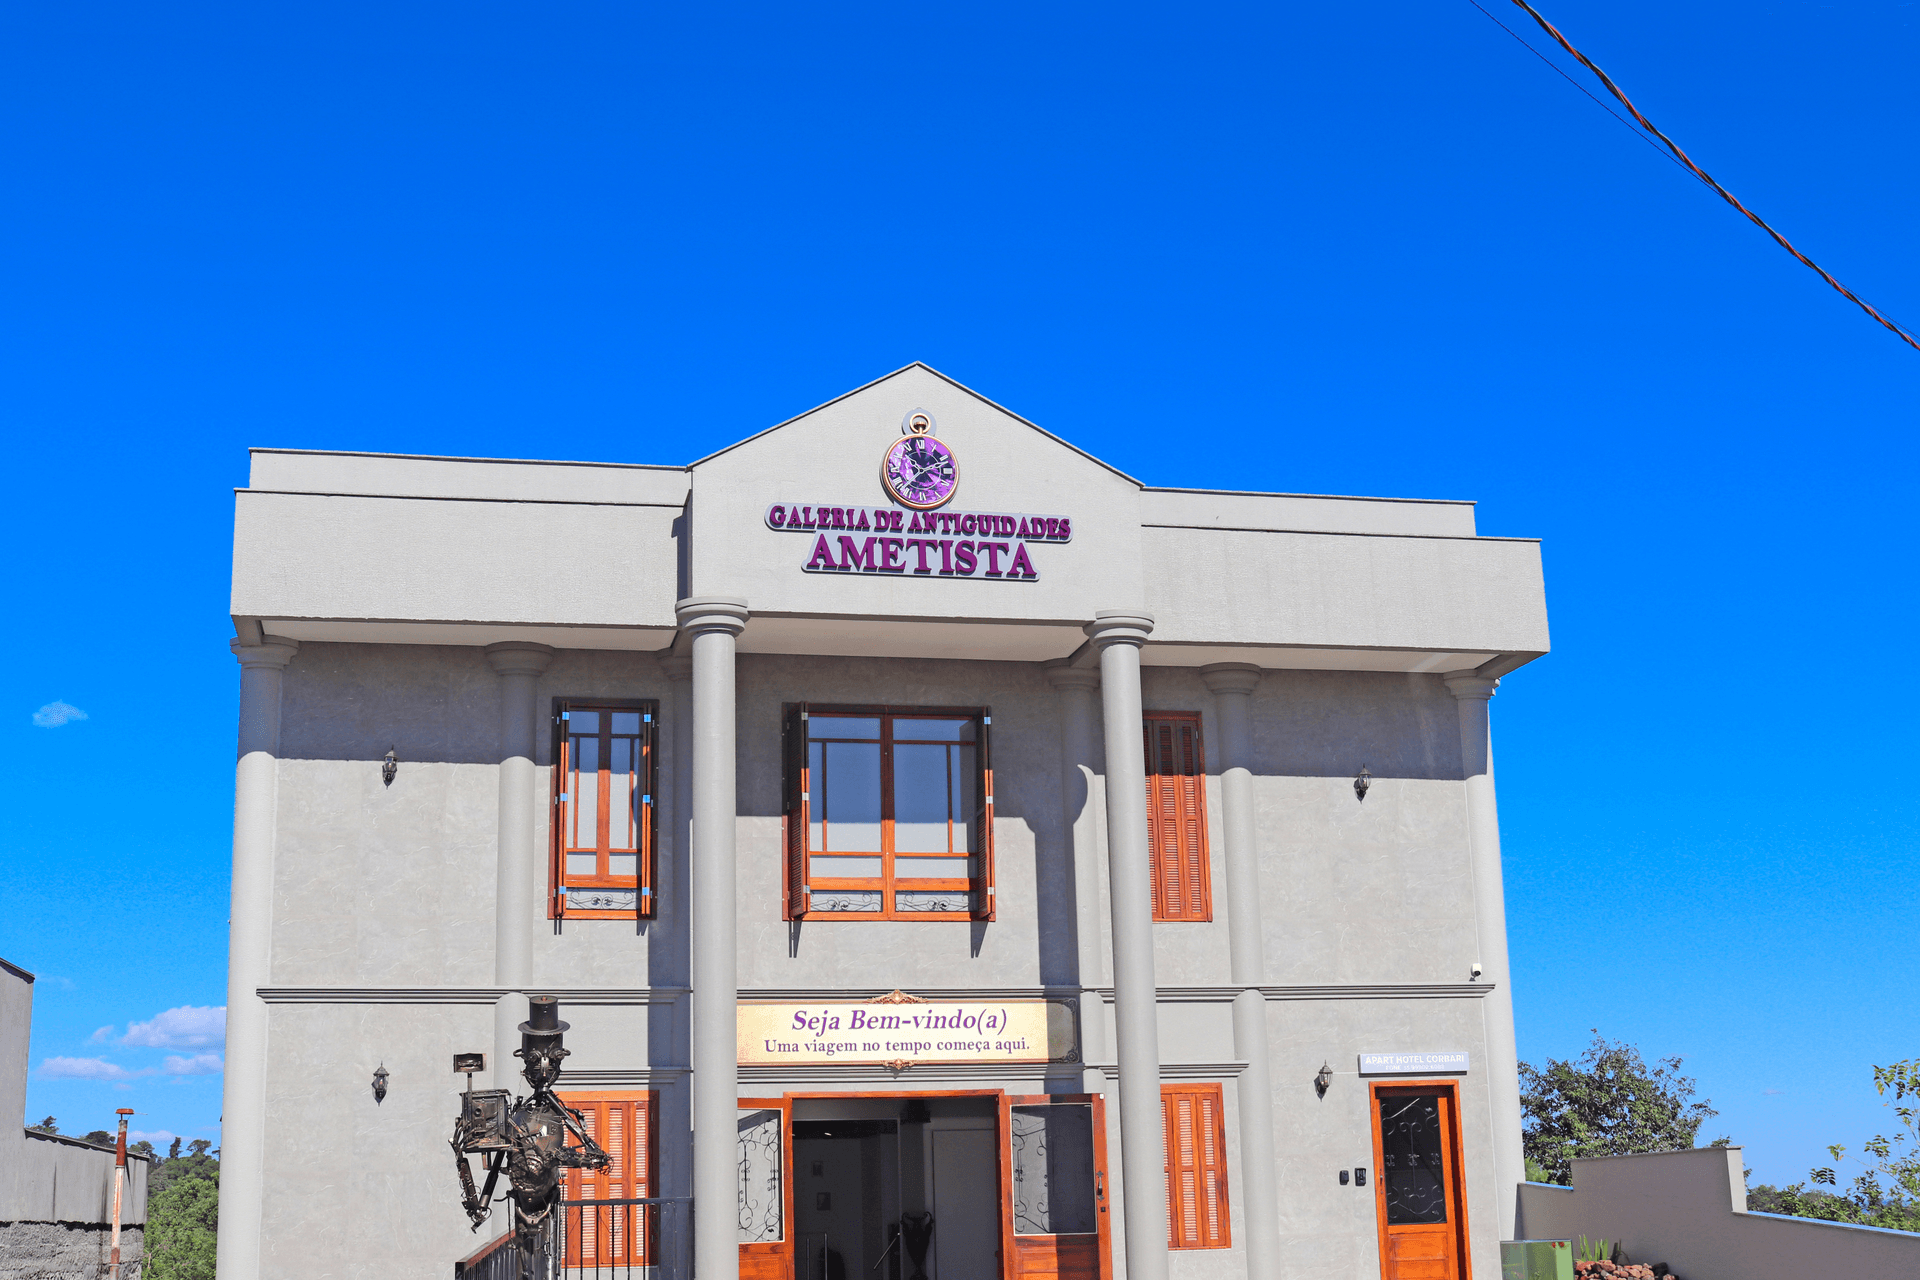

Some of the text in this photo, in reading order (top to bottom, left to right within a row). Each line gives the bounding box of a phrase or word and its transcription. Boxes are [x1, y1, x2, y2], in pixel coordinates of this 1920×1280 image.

[769, 505, 1072, 540] GALERIA DE ANTIGUIDADES
[806, 533, 1038, 579] AMETISTA
[791, 1008, 1008, 1037] Seja Bem-vindo(a)
[764, 1038, 1030, 1057] Uma viagem no tempo começa aqui.
[1365, 1054, 1465, 1064] APART HOTEL CORBARI
